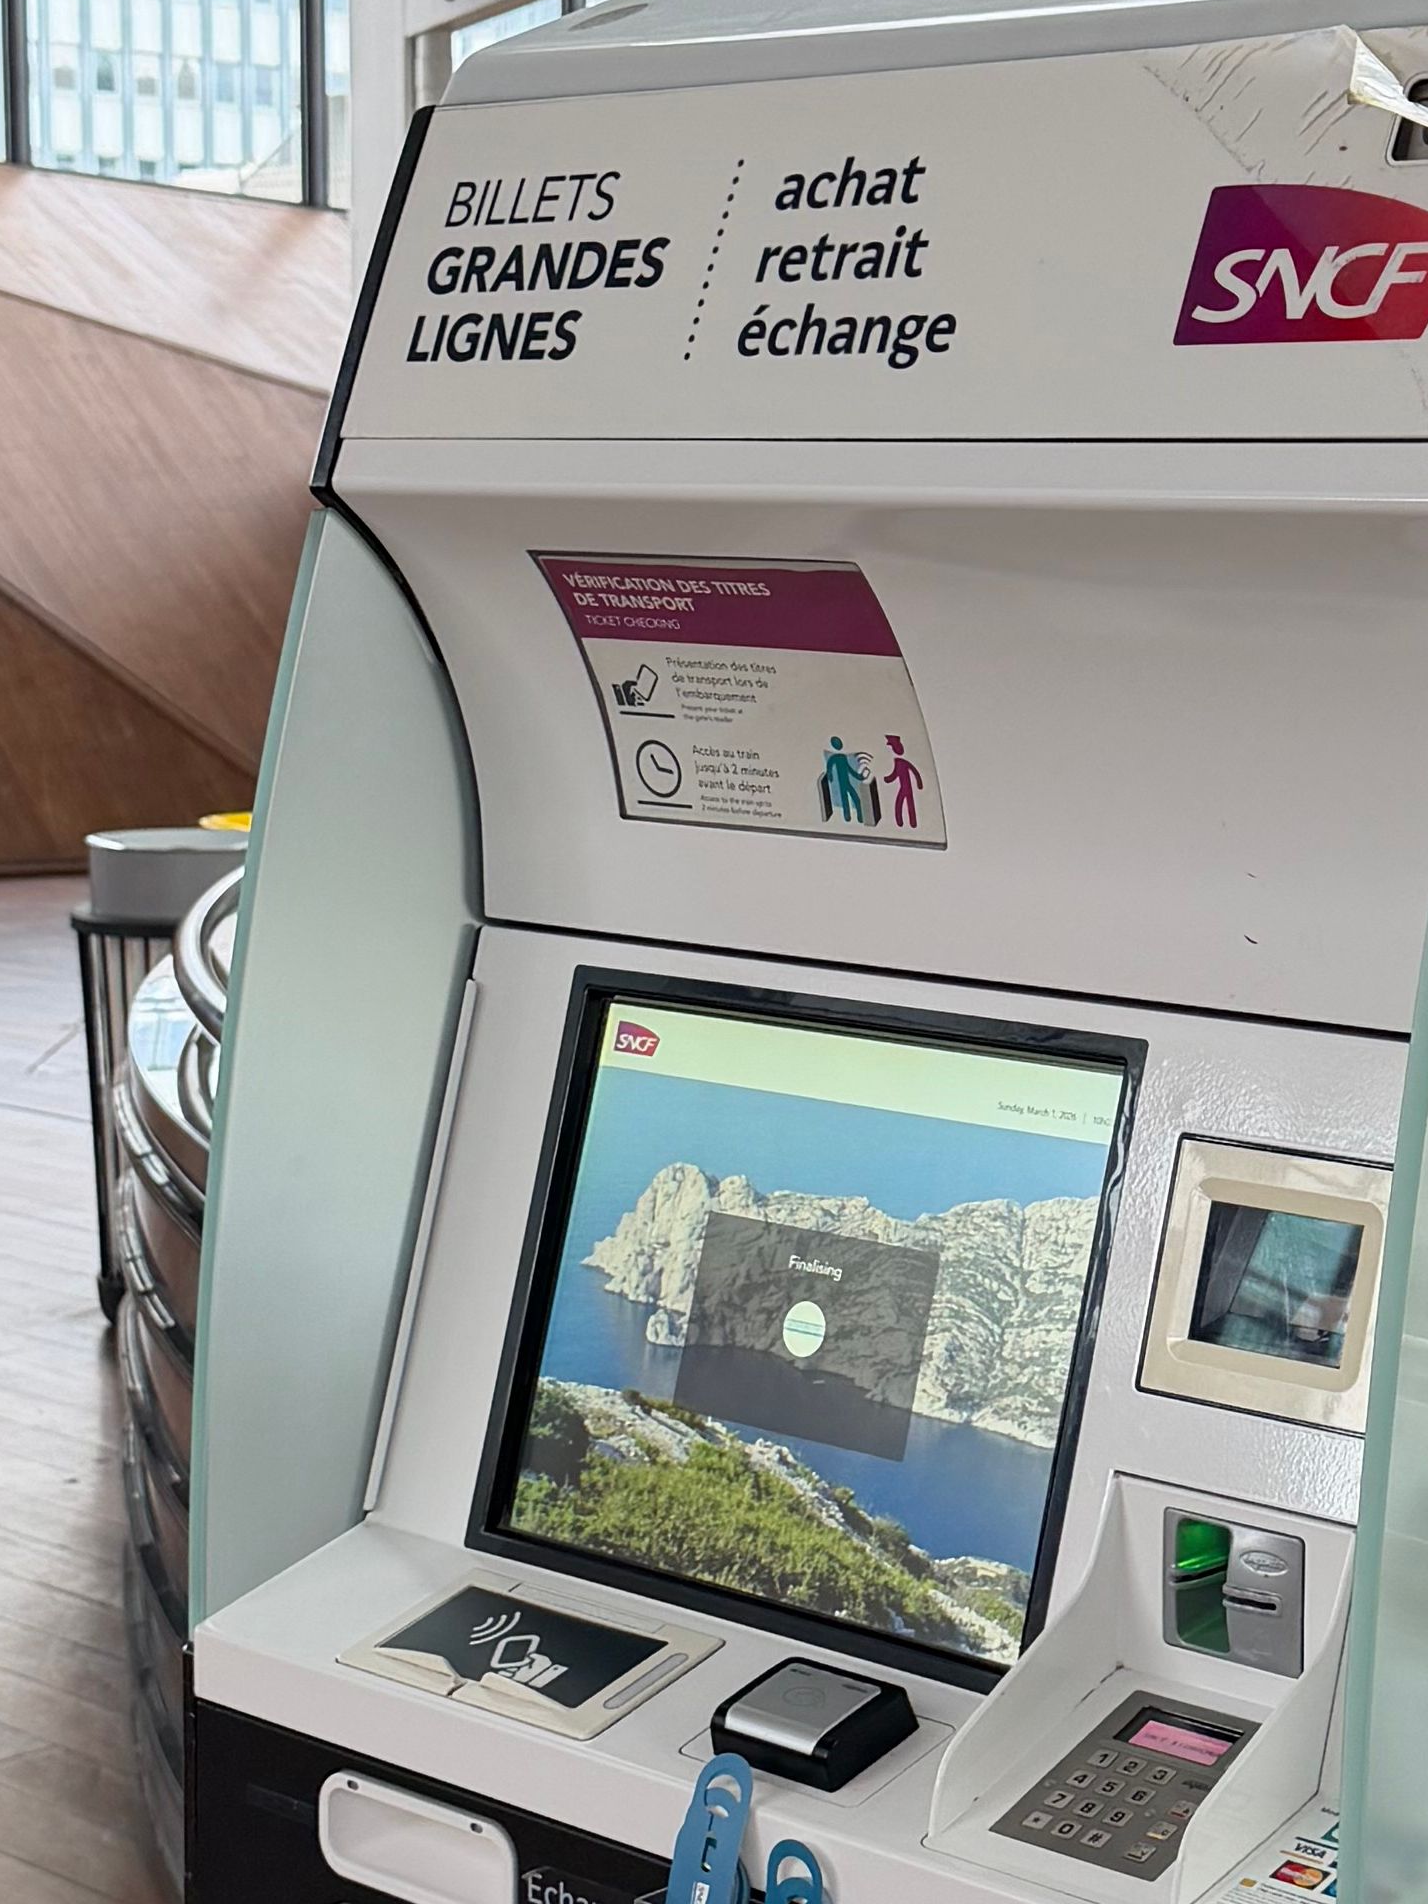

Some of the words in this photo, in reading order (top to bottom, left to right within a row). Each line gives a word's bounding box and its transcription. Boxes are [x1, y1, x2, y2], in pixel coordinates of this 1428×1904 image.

[774, 155, 926, 211] achat
[445, 171, 621, 228] BILLETS
[755, 225, 929, 284] retrait
[426, 236, 671, 295] GRANDES
[406, 309, 582, 363] LIGNES
[736, 302, 957, 370] échange
[562, 572, 676, 593] VÉRIFICATION
[676, 580, 712, 594] DES
[711, 581, 772, 596] TITRES
[573, 592, 599, 607] DE
[599, 593, 695, 612] TRANSPORT
[585, 614, 621, 627] TICKET
[623, 616, 681, 630] CHECKING
[665, 656, 729, 671] Présentation
[730, 661, 749, 672] des
[672, 672, 685, 683] de
[687, 675, 733, 688] transport
[733, 676, 753, 688] lors
[755, 677, 768, 688] de
[692, 744, 720, 757] Accès
[723, 749, 735, 758] au
[737, 748, 760, 760] train
[731, 763, 739, 775] 2
[740, 764, 780, 778] minutes
[698, 779, 724, 790] avant
[726, 778, 736, 791] le
[738, 779, 771, 796] départ
[616, 1033, 658, 1052] SNCF
[788, 1254, 843, 1282] Finalising
[1098, 1752, 1109, 1764] 1
[1123, 1760, 1139, 1773] 2
[1073, 1773, 1088, 1784] 4
[1153, 1769, 1169, 1781] 3
[1102, 1781, 1118, 1793] 5
[1051, 1793, 1066, 1804] 7
[1131, 1790, 1148, 1802] 6
[1080, 1802, 1096, 1814] 8
[1109, 1811, 1125, 1823] 9
[1058, 1823, 1074, 1834] 0
[1294, 1842, 1327, 1859] VISA
